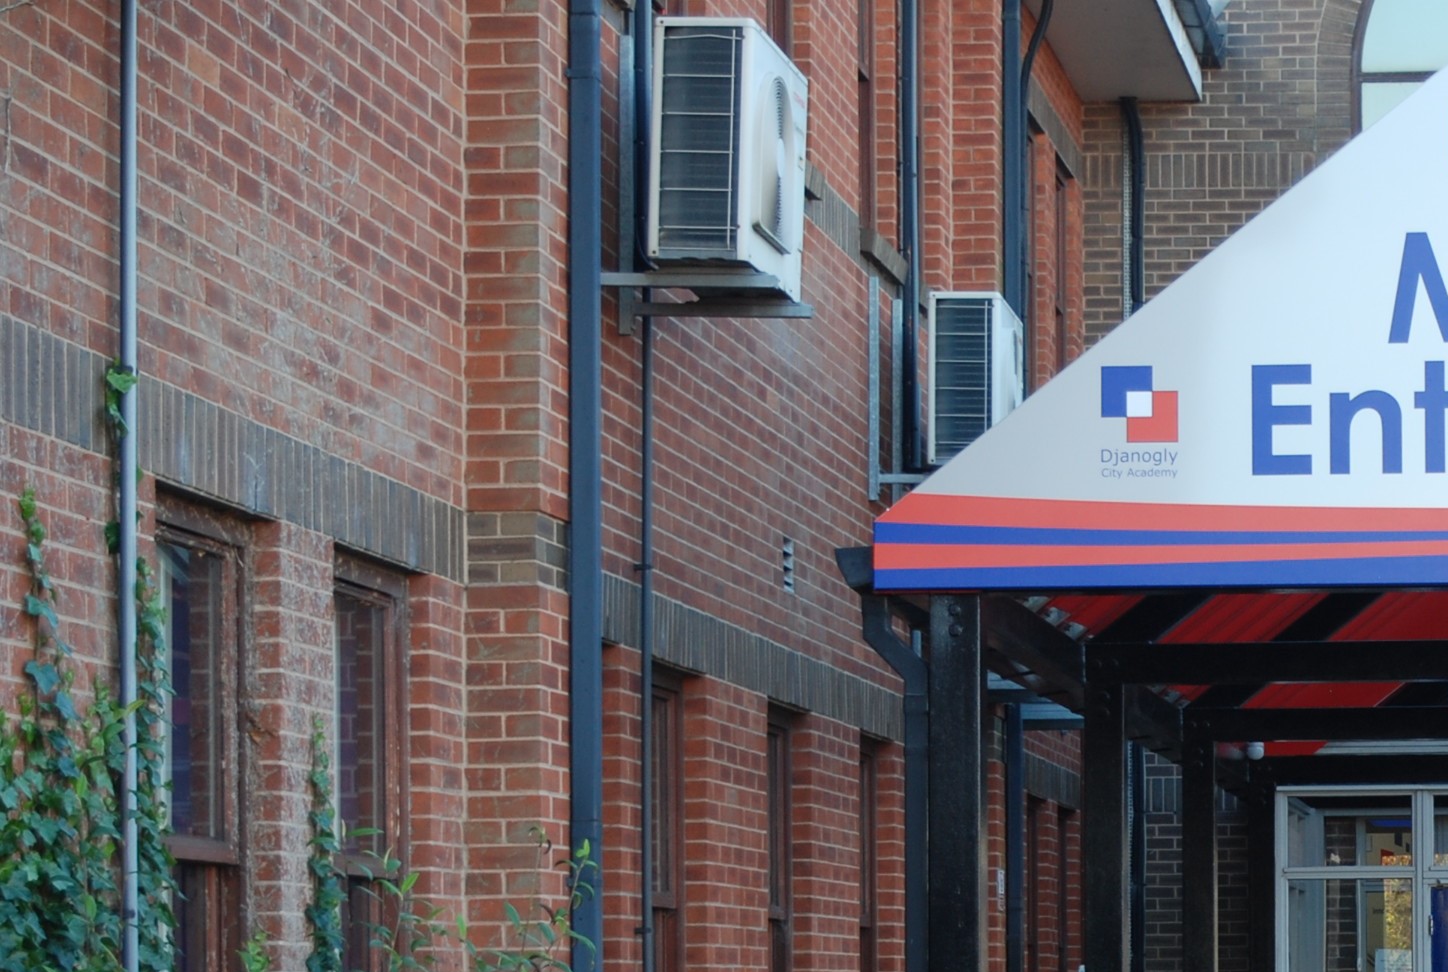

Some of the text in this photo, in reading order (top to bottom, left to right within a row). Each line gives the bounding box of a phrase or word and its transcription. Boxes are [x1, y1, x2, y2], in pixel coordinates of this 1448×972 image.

[1100, 447, 1178, 467] Djanogly
[1100, 467, 1178, 480] City Academy
